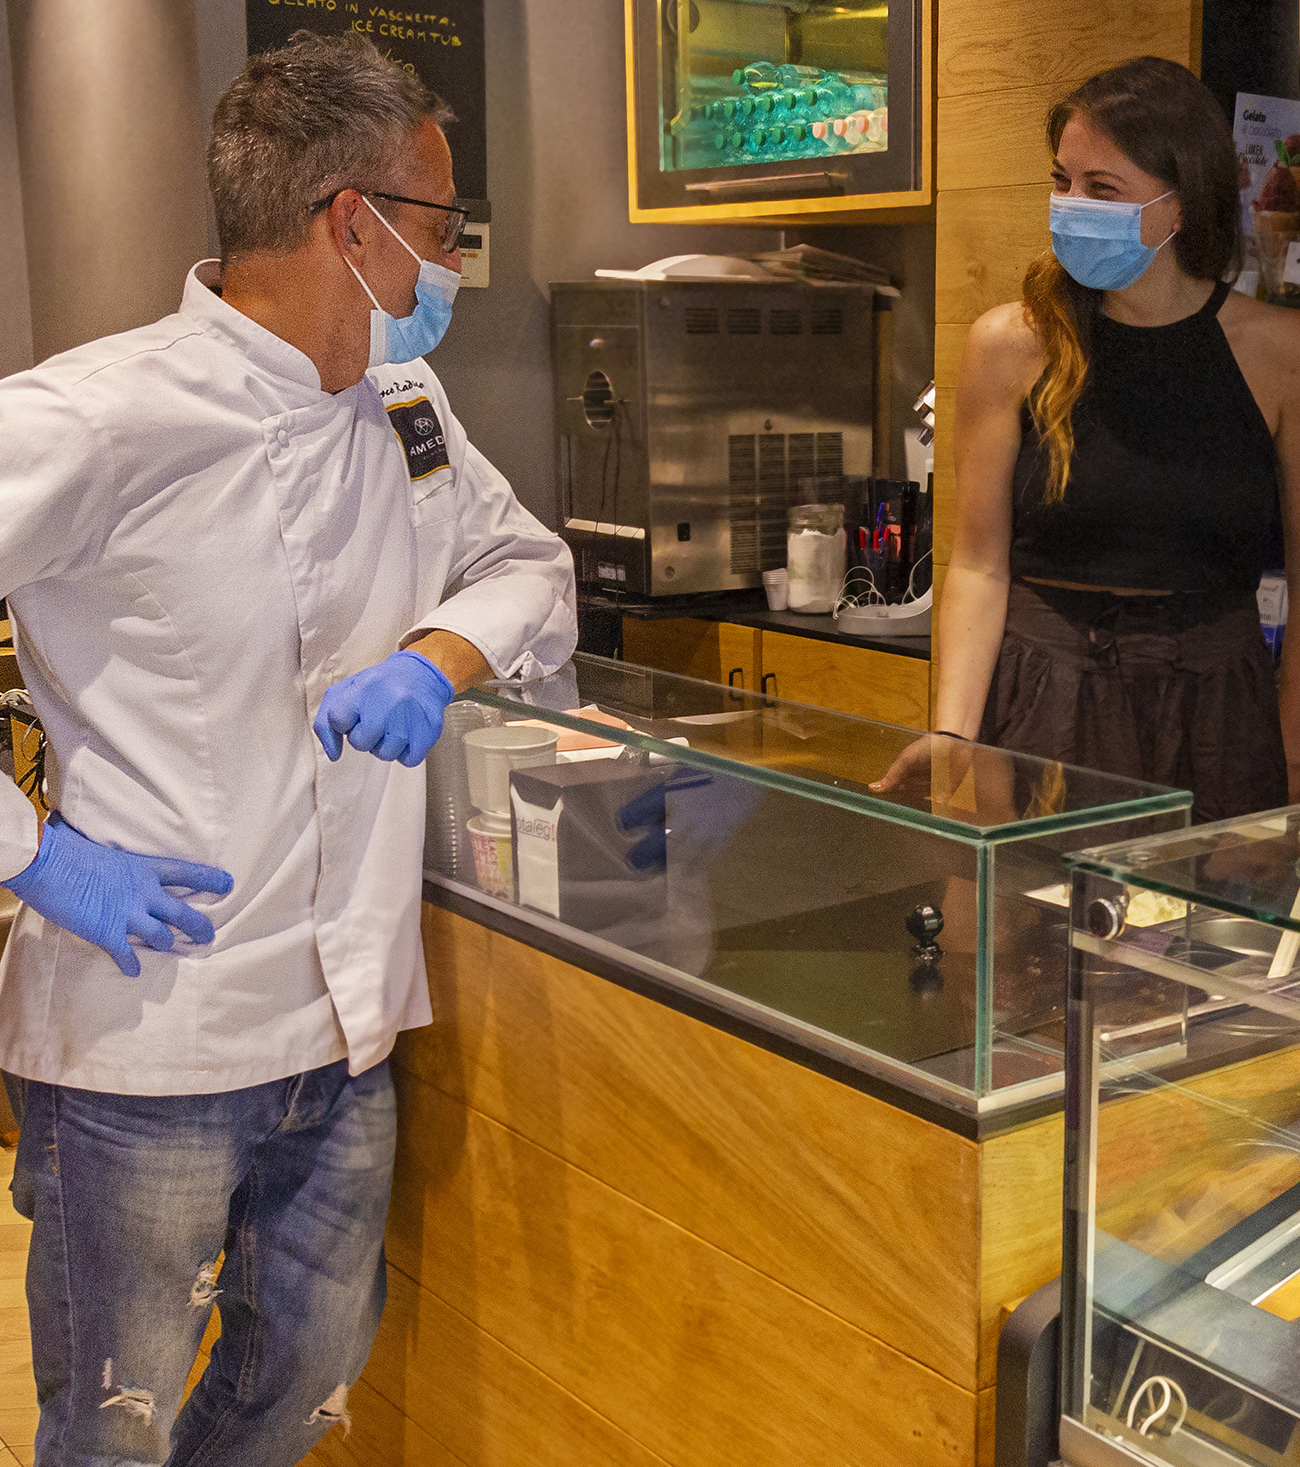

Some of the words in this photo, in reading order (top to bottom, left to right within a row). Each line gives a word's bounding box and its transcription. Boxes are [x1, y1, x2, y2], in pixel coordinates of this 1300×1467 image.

[346, 2, 359, 14] IN
[351, 19, 374, 33] ICE
[1243, 109, 1267, 123] Gelato
[409, 435, 446, 457] AMED
